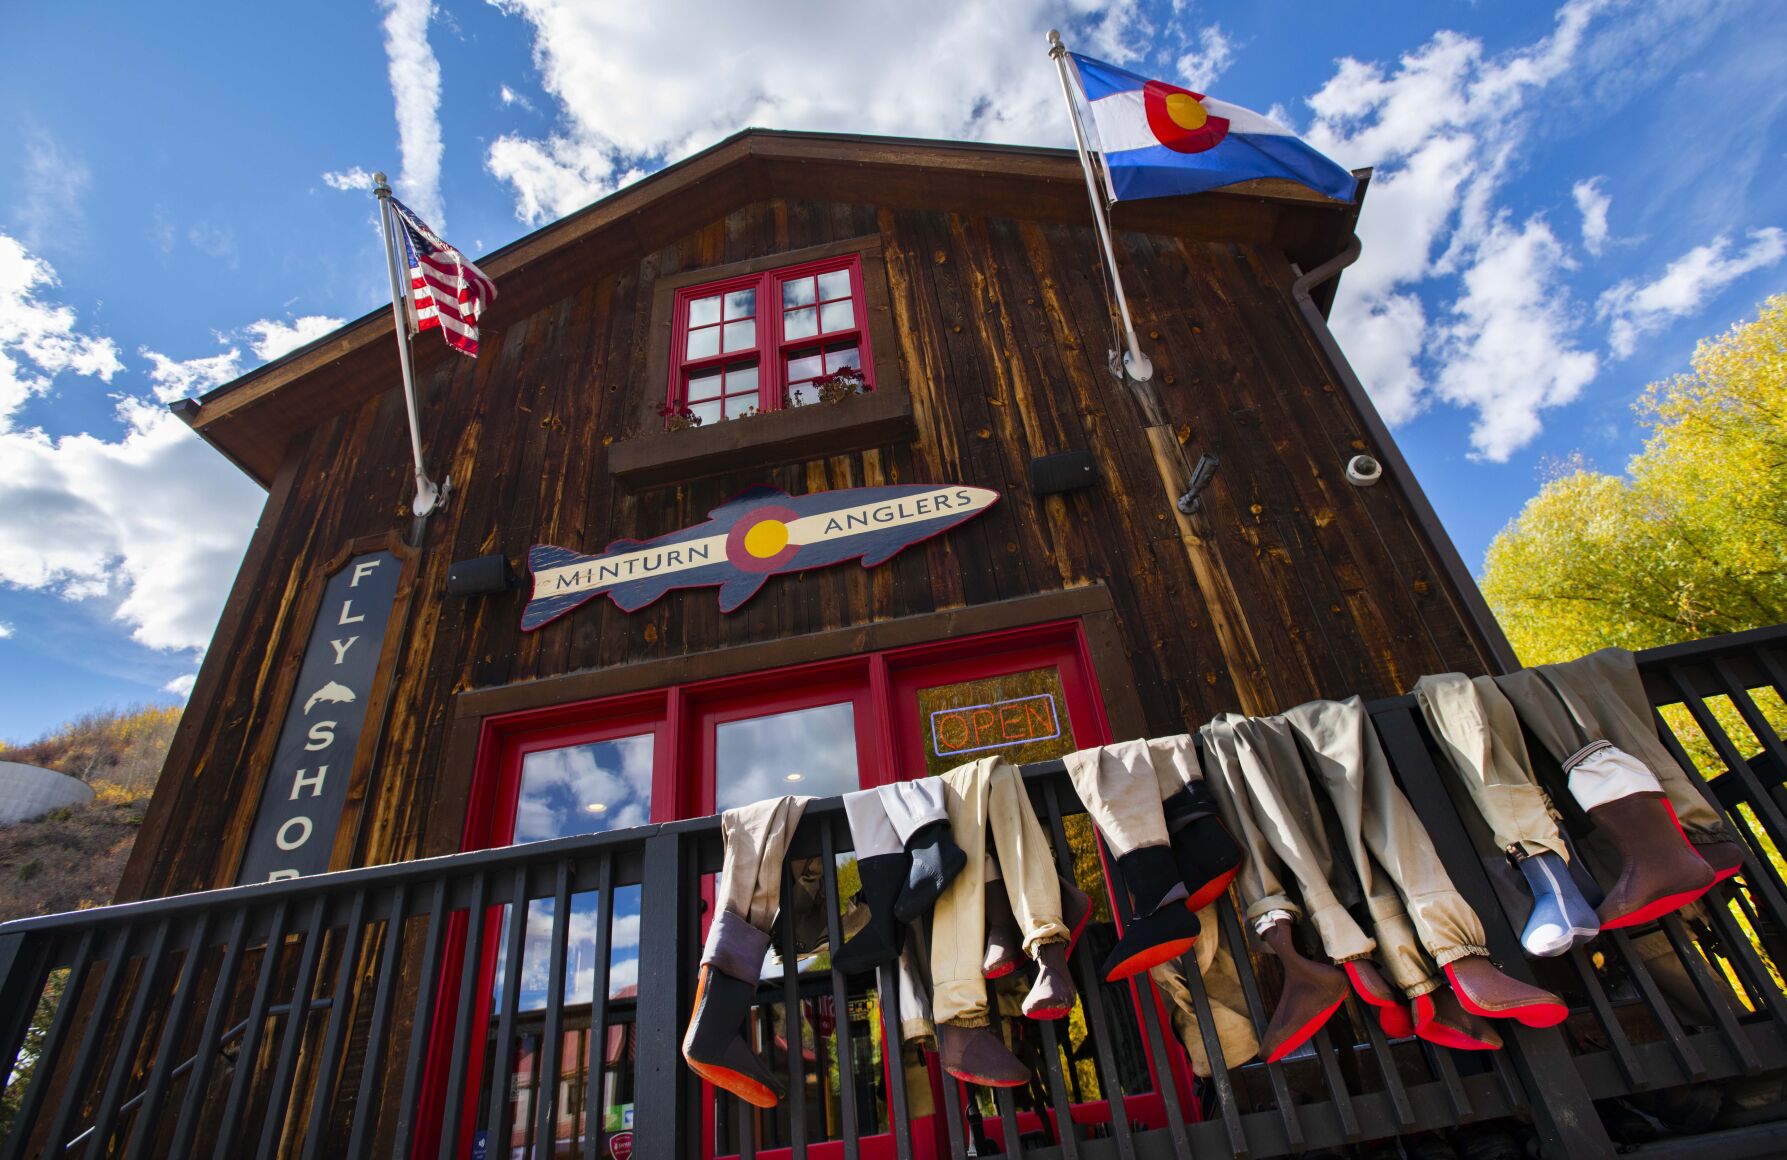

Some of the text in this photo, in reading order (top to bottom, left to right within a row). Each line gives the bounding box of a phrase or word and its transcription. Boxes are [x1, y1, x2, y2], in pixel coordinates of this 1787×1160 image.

[556, 489, 972, 590] MINTURN ANGLERS
[329, 559, 381, 665] FLY
[939, 699, 1054, 749] OPEN
